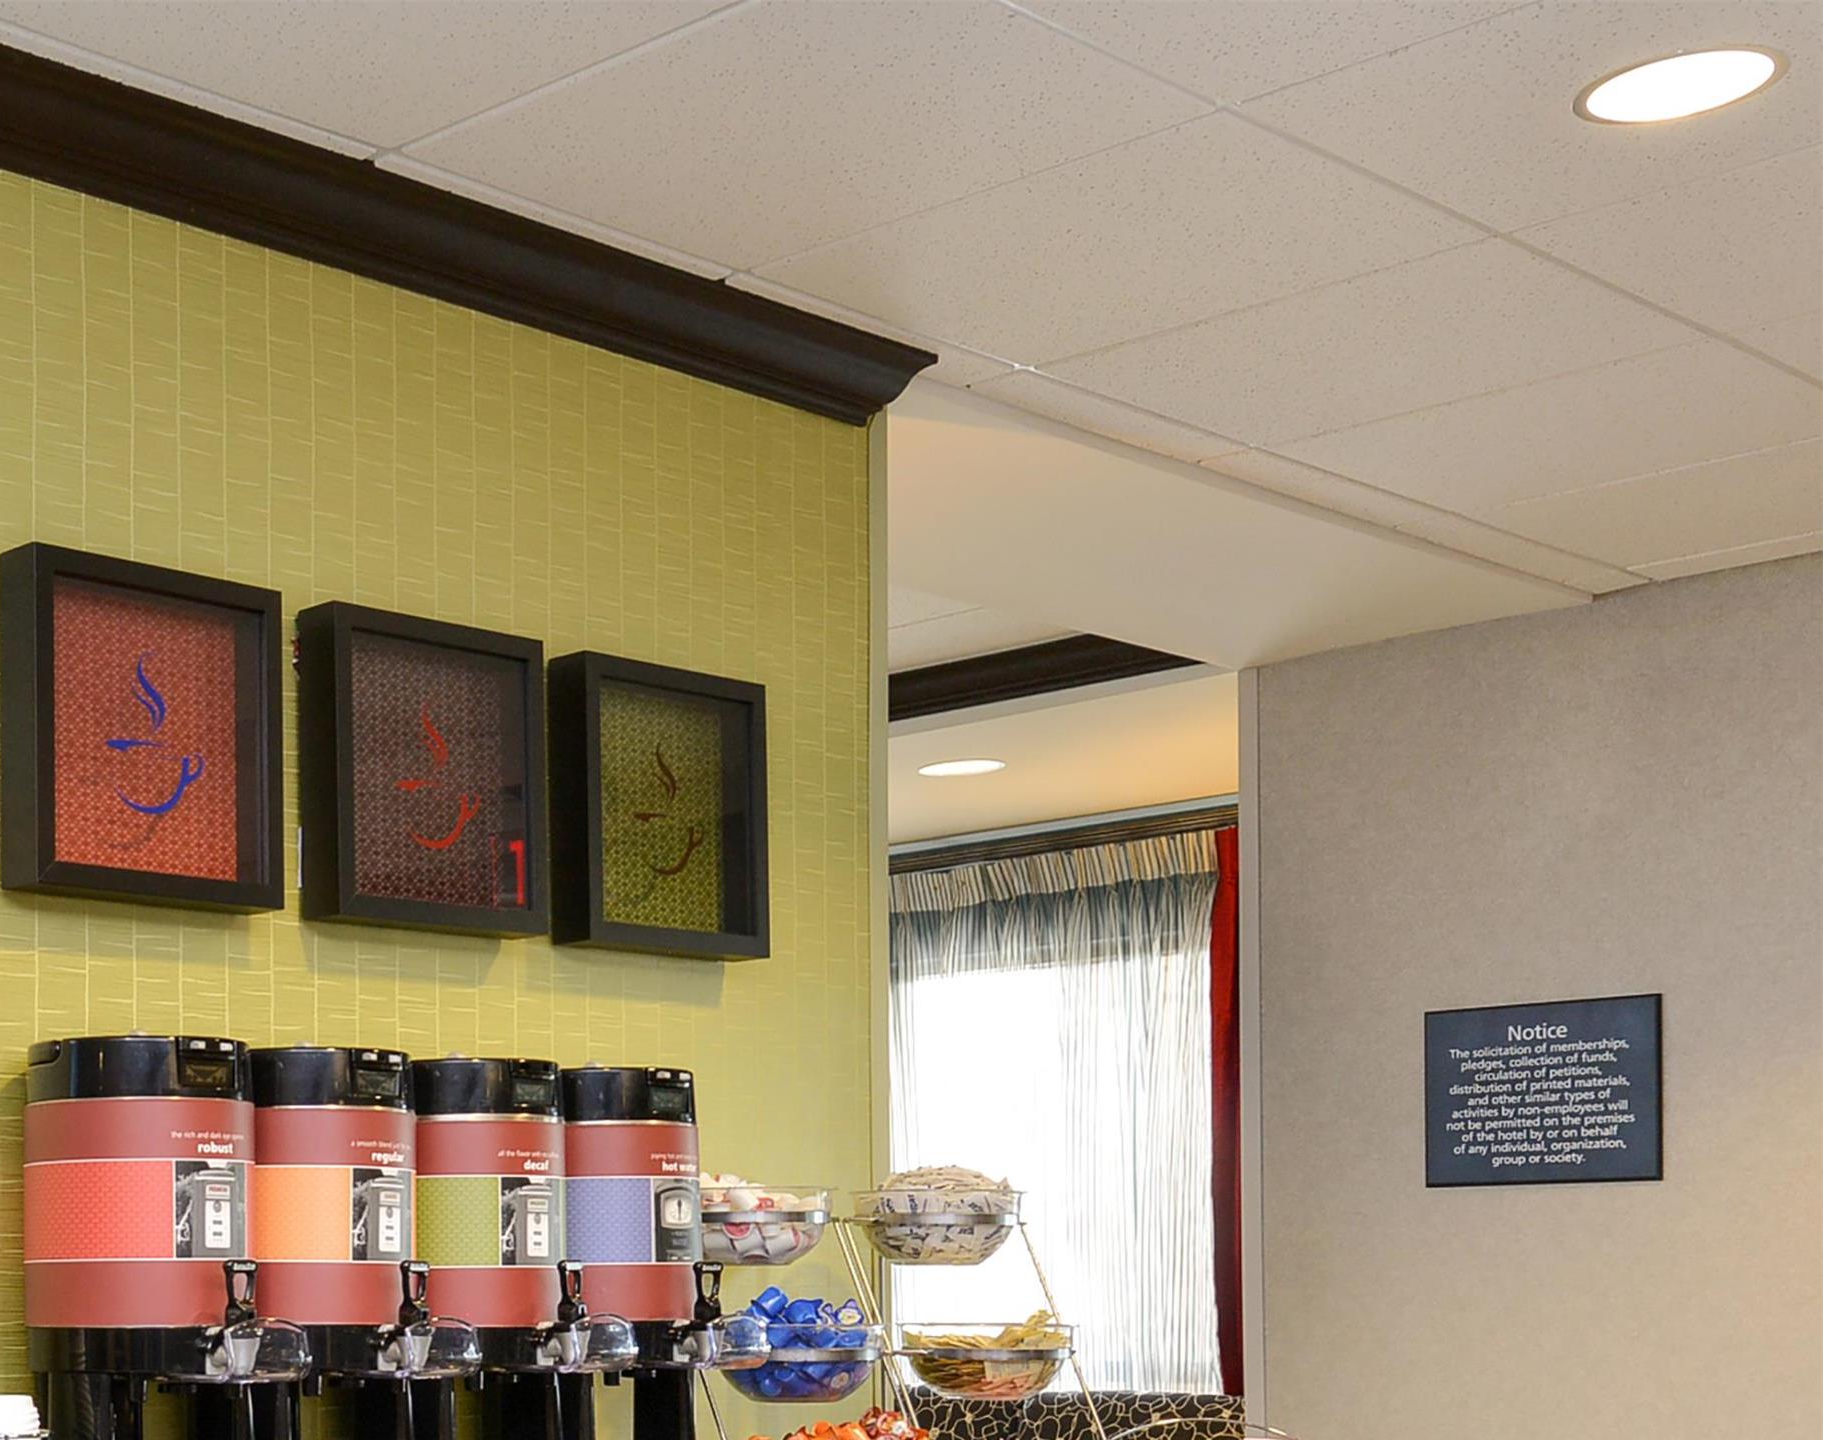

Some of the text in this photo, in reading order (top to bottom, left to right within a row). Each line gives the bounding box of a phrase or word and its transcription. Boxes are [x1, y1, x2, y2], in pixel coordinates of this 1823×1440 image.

[1507, 1022, 1568, 1041] Notice
[1449, 1038, 1630, 1059] The solicitation of memberships,
[1460, 1050, 1617, 1072] pledges, collection of funds,
[1474, 1065, 1602, 1081] circulation of petitions,
[1449, 1074, 1630, 1095] distribution of printed materials,
[1467, 1087, 1611, 1106] and other similar types of
[1452, 1099, 1628, 1119] activities by non-employees will
[1446, 1112, 1635, 1131] not be permitted on the premises
[1461, 1124, 1618, 1142] of the hotel by or on behalf
[197, 1140, 234, 1154] robust
[1453, 1138, 1627, 1156] of any individual, organization,
[371, 1151, 405, 1165] regular
[523, 1158, 550, 1171] decaf
[662, 1160, 678, 1171] hot
[1492, 1153, 1586, 1167] group or society.
